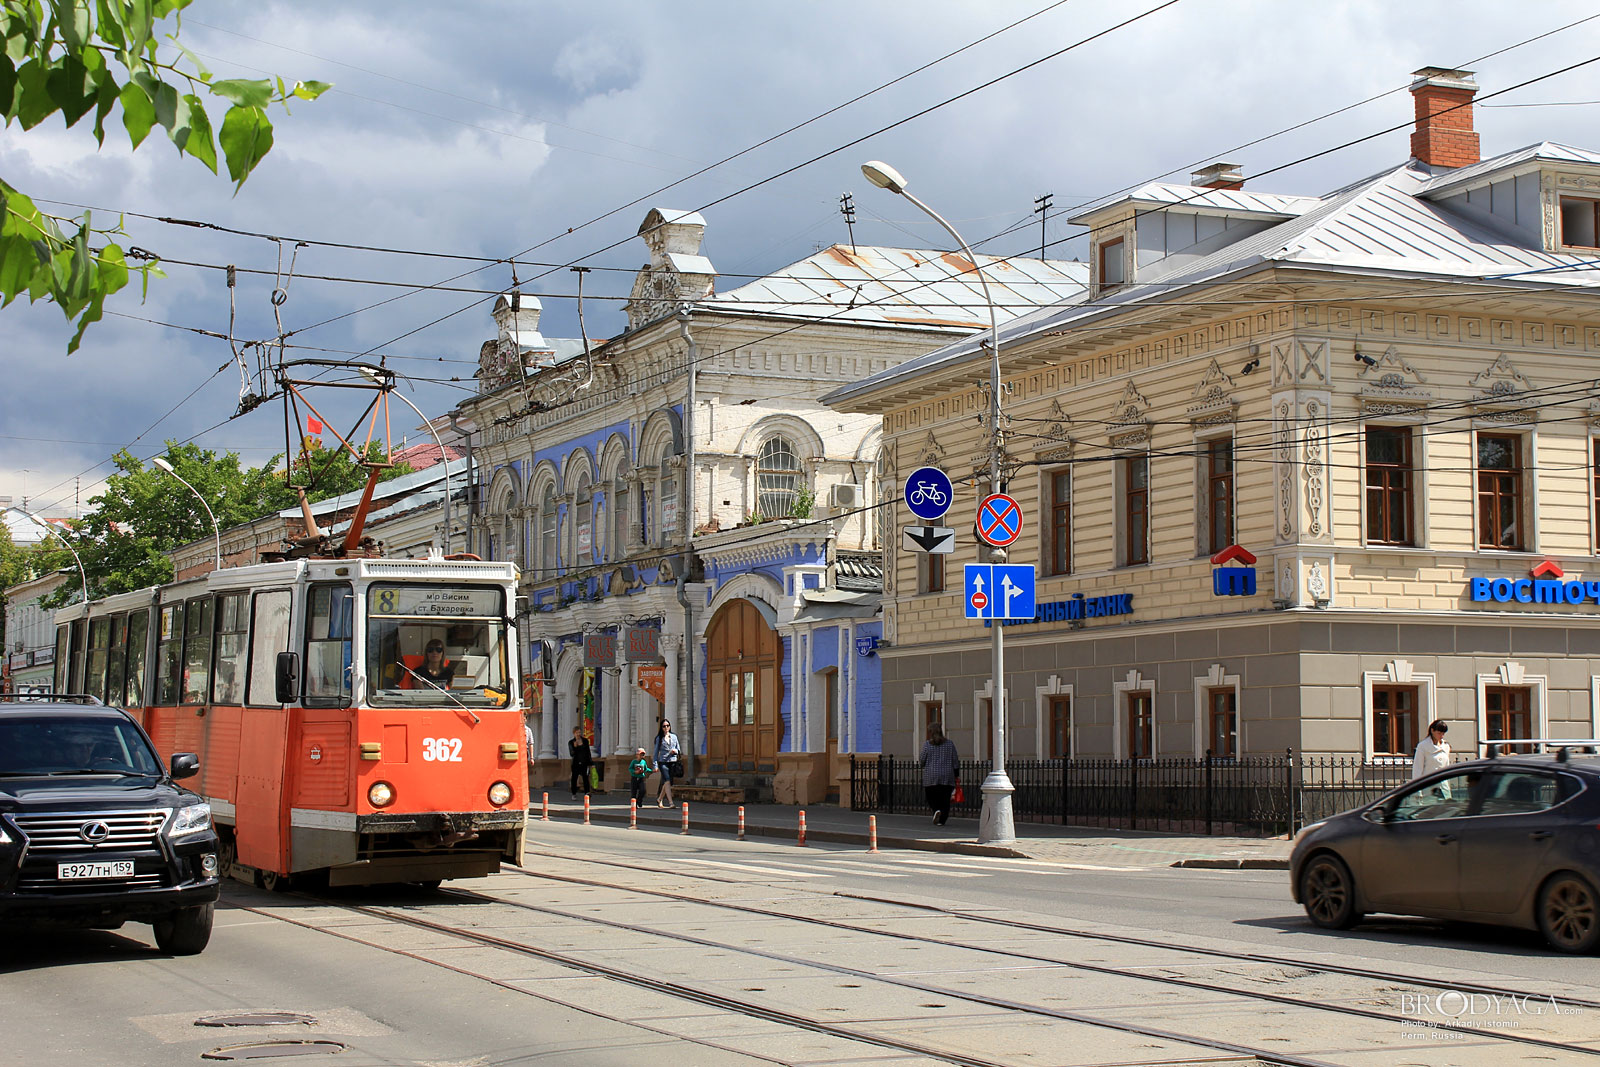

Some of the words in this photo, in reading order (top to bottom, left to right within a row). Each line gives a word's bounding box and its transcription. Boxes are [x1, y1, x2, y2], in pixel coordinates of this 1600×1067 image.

[380, 590, 395, 613] 8
[442, 593, 470, 601] Висим
[1086, 594, 1127, 618] БАНК
[430, 605, 474, 613] Бахаревка
[422, 737, 463, 762] 362
[62, 864, 111, 878] Е927ТН
[113, 862, 132, 872] 159
